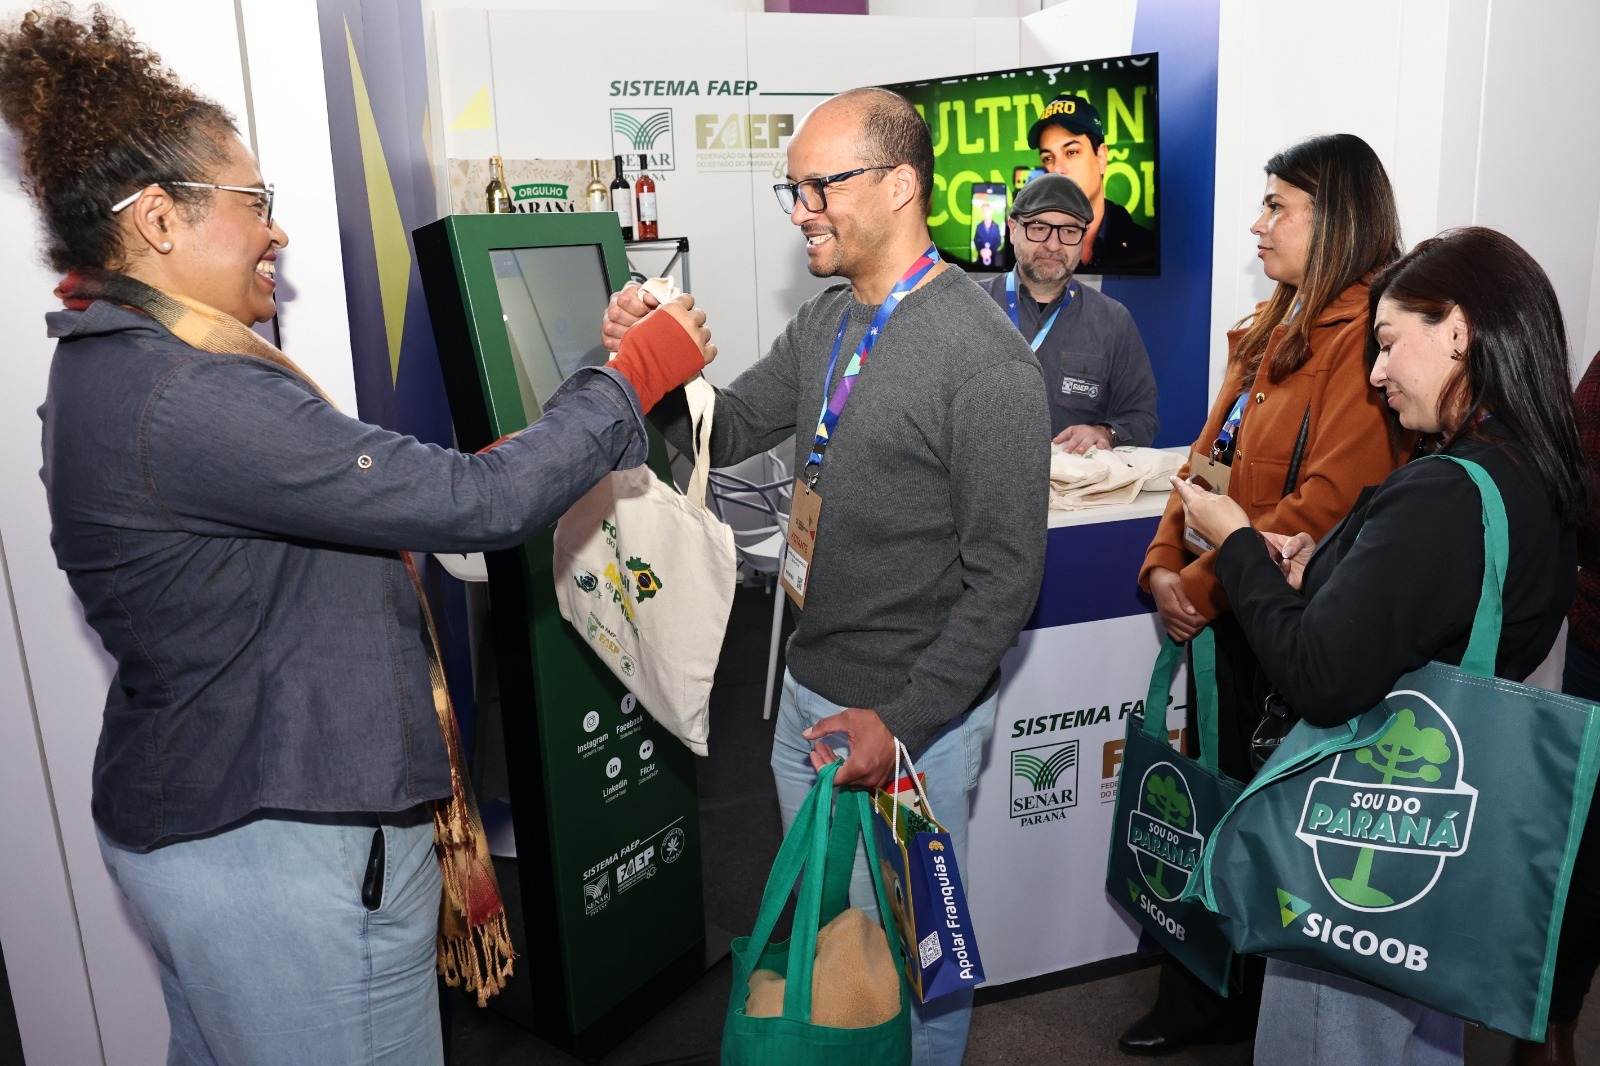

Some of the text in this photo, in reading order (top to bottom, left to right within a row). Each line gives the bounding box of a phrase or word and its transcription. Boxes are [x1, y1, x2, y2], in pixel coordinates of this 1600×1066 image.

[609, 80, 758, 97] SISTEMA FAEP
[695, 114, 794, 149] FAEP
[696, 152, 736, 160] FEDERAÇÃO
[518, 186, 563, 198] ORGULHO
[616, 714, 644, 735] Facebook
[1011, 705, 1111, 738] SISTEMA
[577, 732, 609, 754] Instagram
[640, 762, 656, 777] Flickr
[1013, 789, 1073, 812] SENAR
[1100, 791, 1112, 799] DO
[1351, 792, 1421, 815] SOU DO
[1020, 807, 1067, 828] PARANÁ
[1308, 803, 1460, 849] PARANÁ
[1149, 822, 1180, 845] SOU DO
[582, 852, 619, 881] SISTEMA
[620, 839, 641, 858] FAEP
[1132, 826, 1197, 871] PARANÁ
[616, 845, 655, 885] FAEP
[933, 855, 974, 980] Apolar Franquias
[1140, 894, 1186, 941] SICOOB
[1302, 912, 1429, 973] SICOOB
